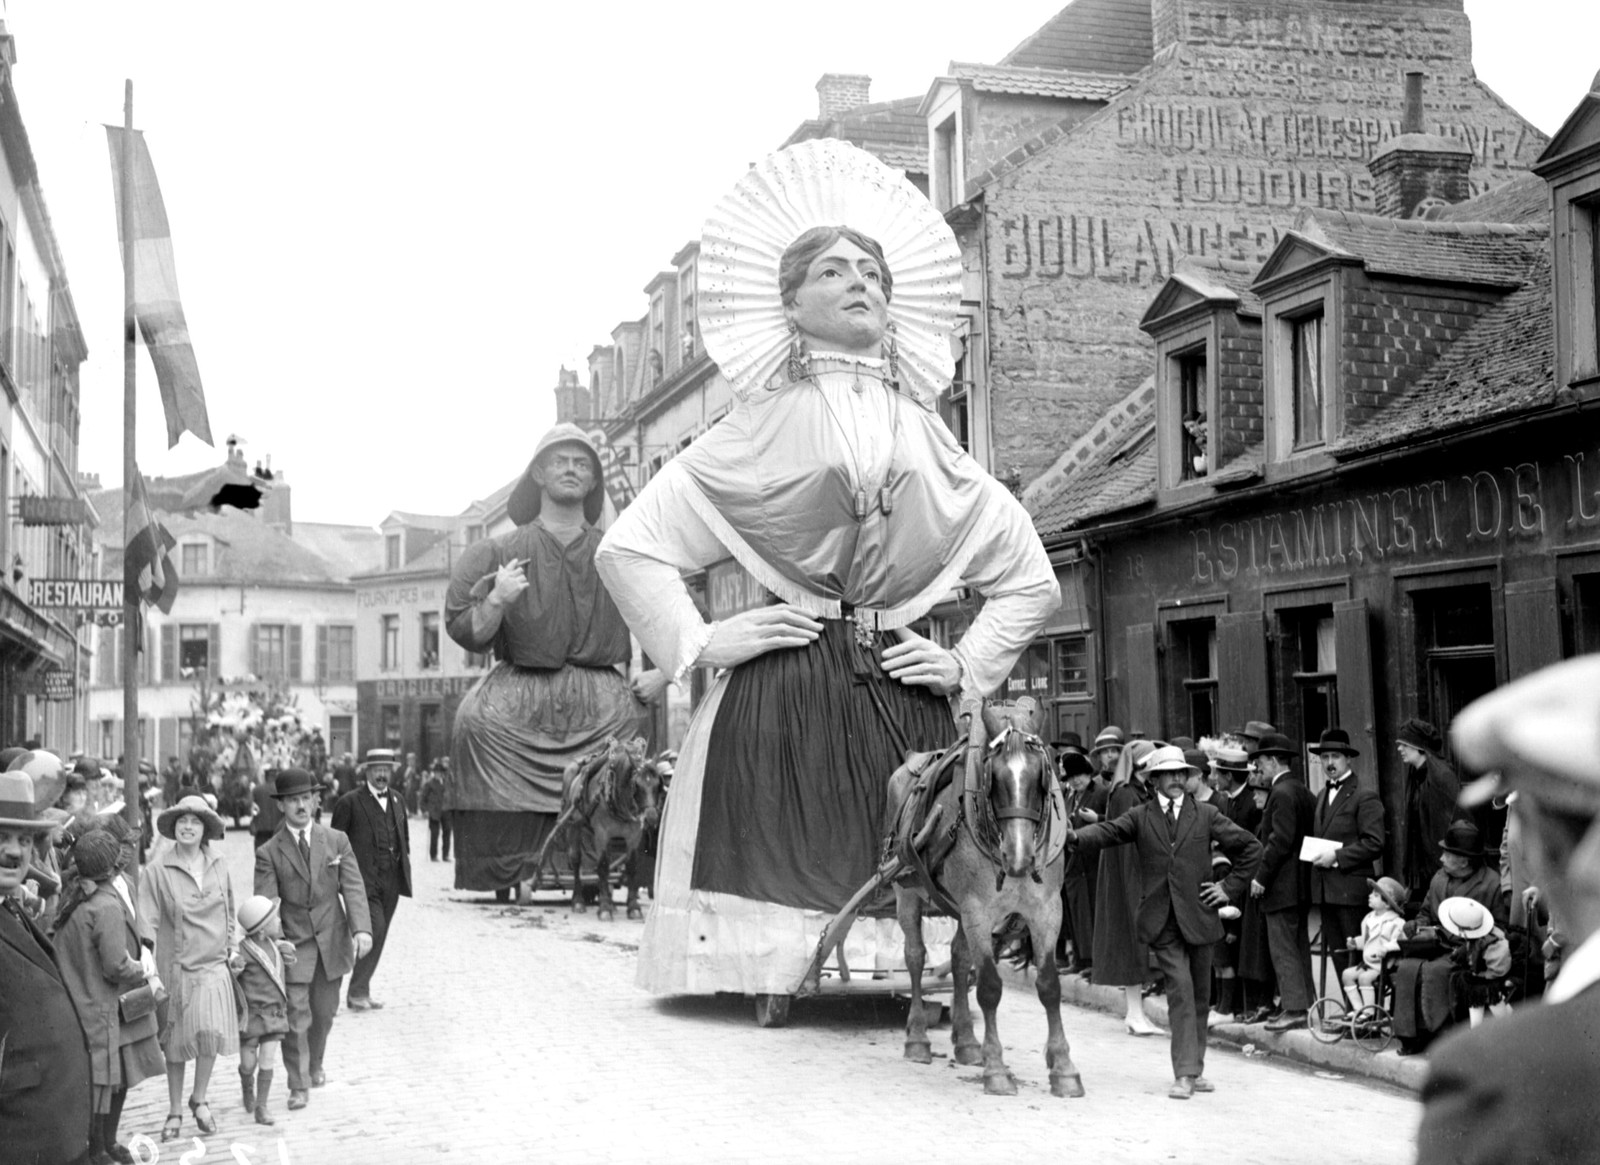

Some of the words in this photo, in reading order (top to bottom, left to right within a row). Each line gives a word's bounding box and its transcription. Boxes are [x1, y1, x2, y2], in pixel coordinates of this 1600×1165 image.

[1115, 102, 1273, 157] CHOCOLAT
[1001, 212, 1280, 283] BOULANGER
[586, 428, 634, 504] COIFF
[25, 500, 79, 520] HOTEL
[1189, 479, 1446, 583] ESTAMINET
[1462, 461, 1544, 539] DE
[1564, 451, 1600, 523] L
[1126, 554, 1145, 580] 18
[33, 581, 123, 607] RESTAURAN
[376, 677, 470, 697] DROGUERIE
